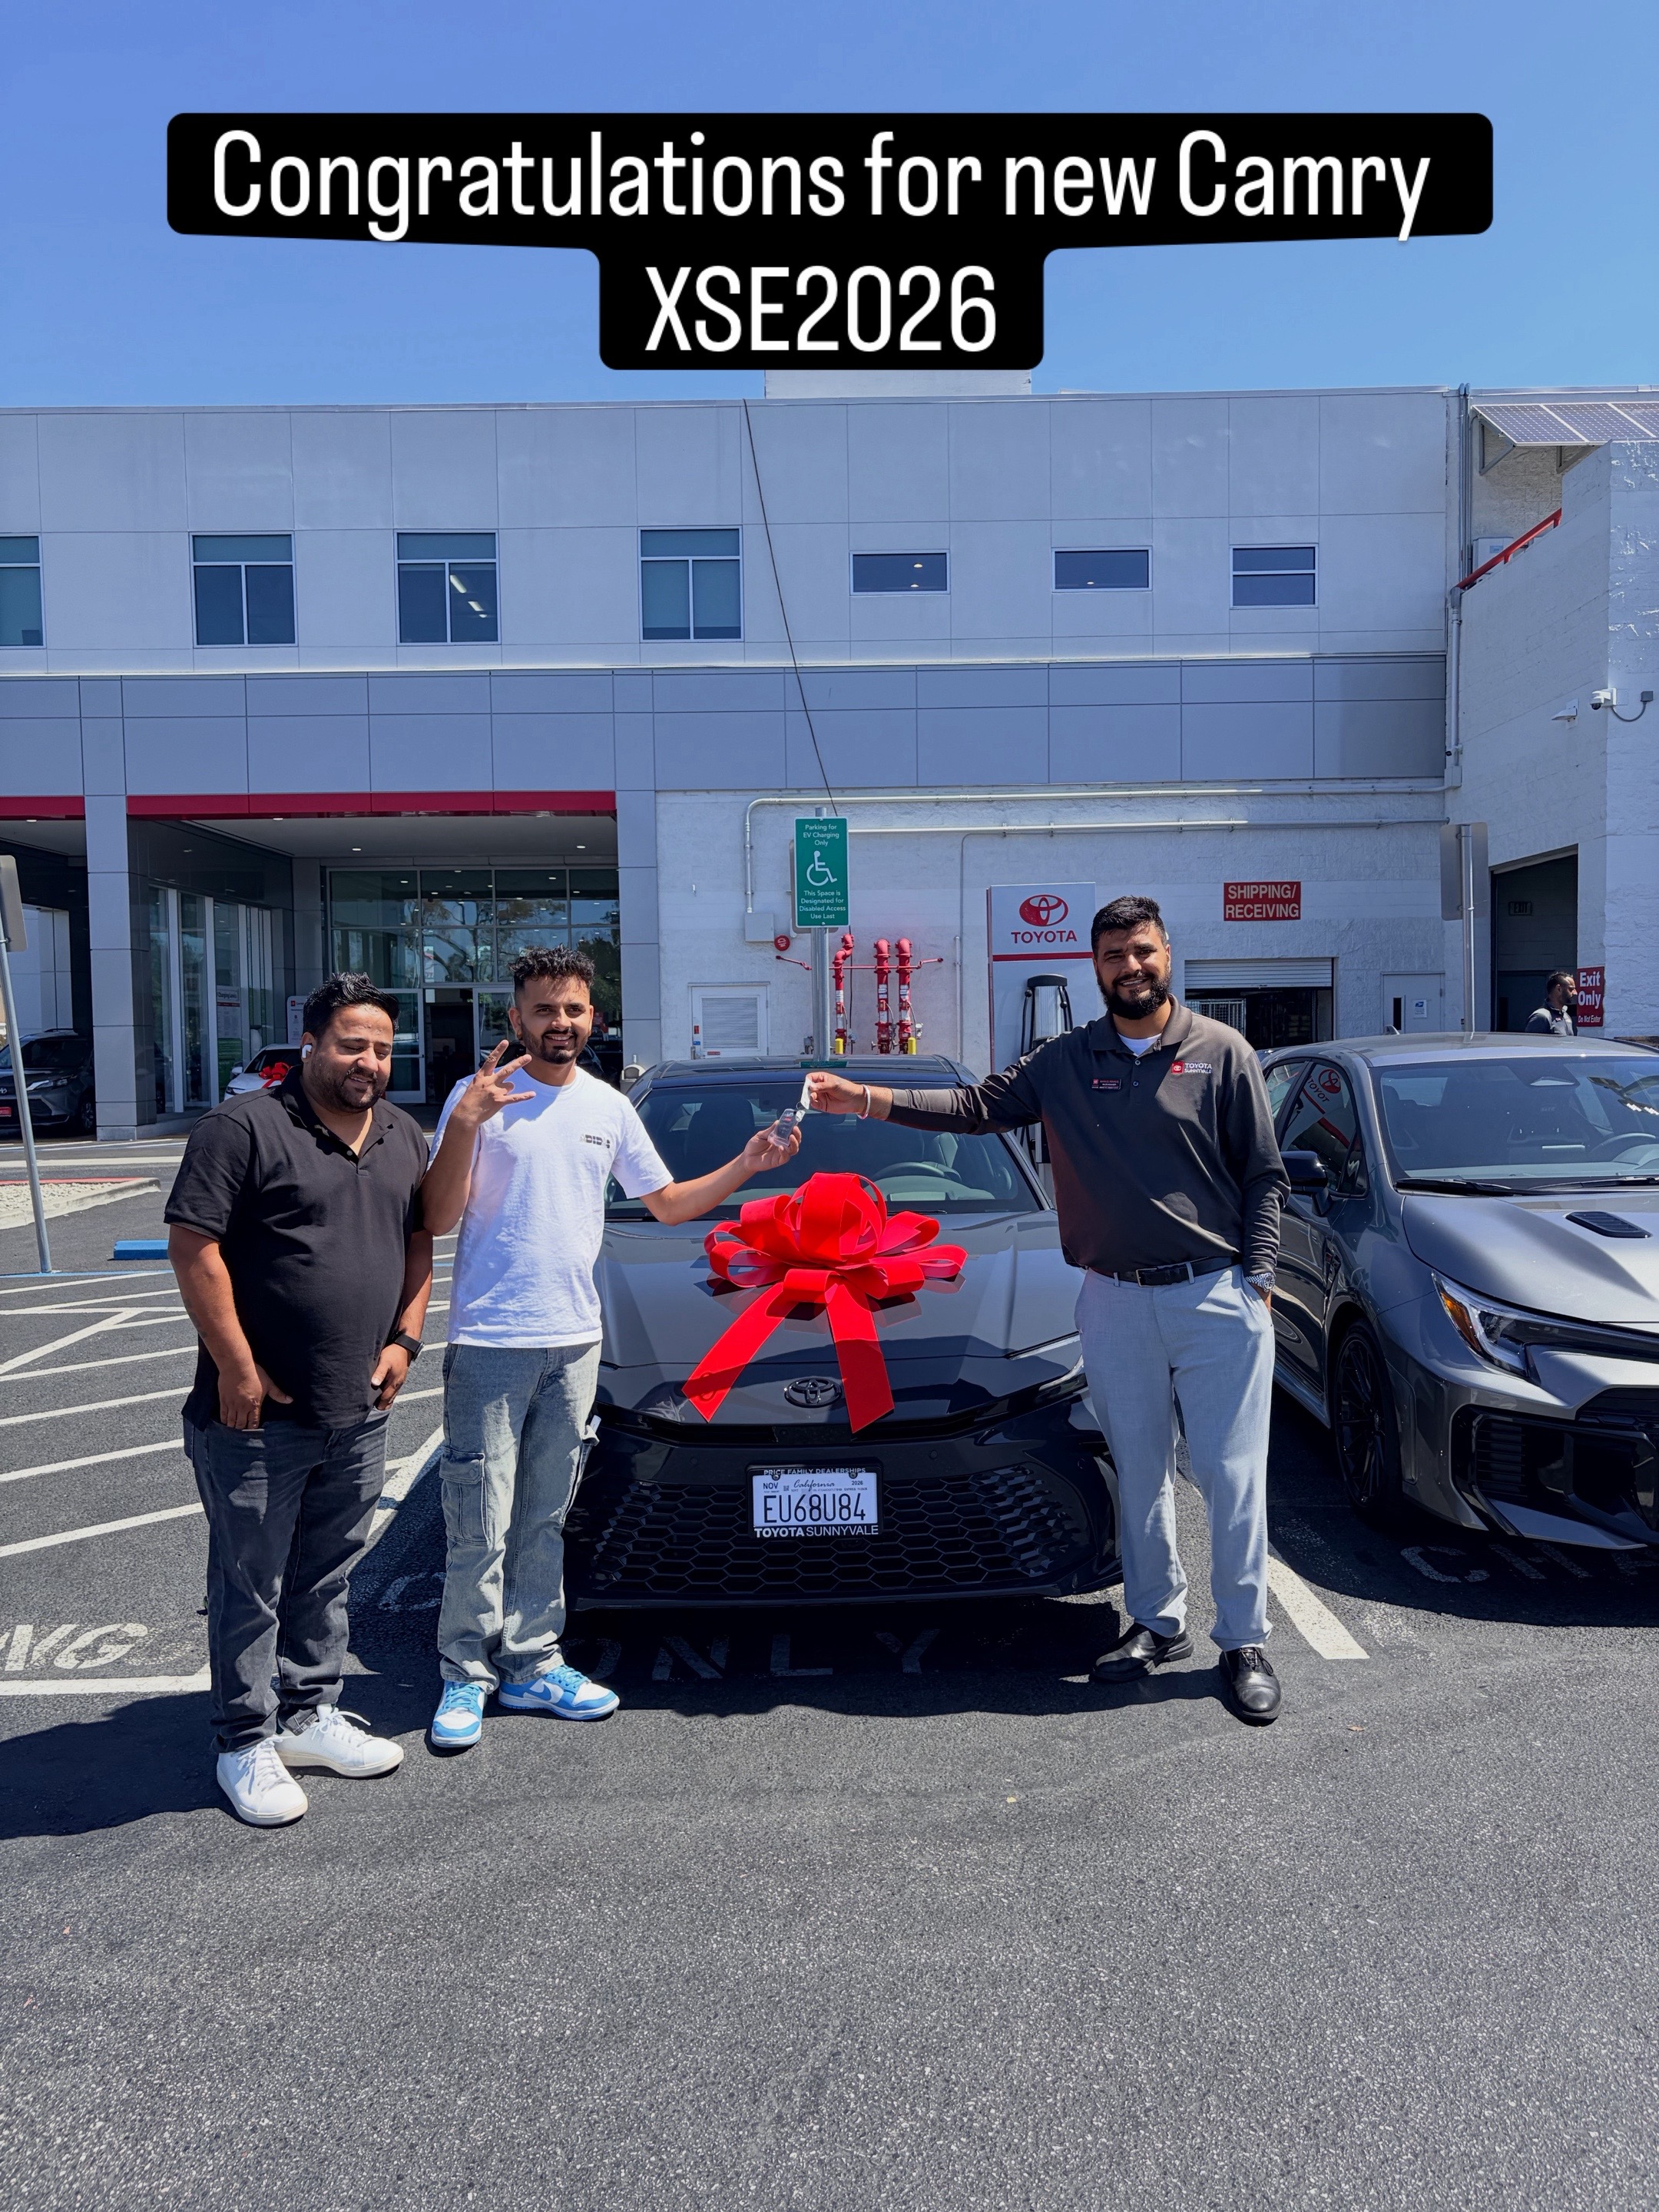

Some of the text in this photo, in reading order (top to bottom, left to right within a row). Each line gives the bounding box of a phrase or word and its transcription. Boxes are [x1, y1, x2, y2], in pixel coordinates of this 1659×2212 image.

[1227, 884, 1296, 899] SHIPPING/
[1225, 902, 1300, 919] RECEIVING
[1513, 902, 1528, 914] EXIT
[1011, 929, 1078, 944] TOYOTA
[1579, 971, 1601, 987] Exit
[1578, 990, 1601, 1009] Only
[1578, 1015, 1584, 1023] Do
[1591, 1015, 1601, 1023] Enter
[793, 1479, 836, 1492] California
[763, 1492, 866, 1524] EU68U84
[753, 1525, 879, 1538] TOYOTA SUNNYVALE
